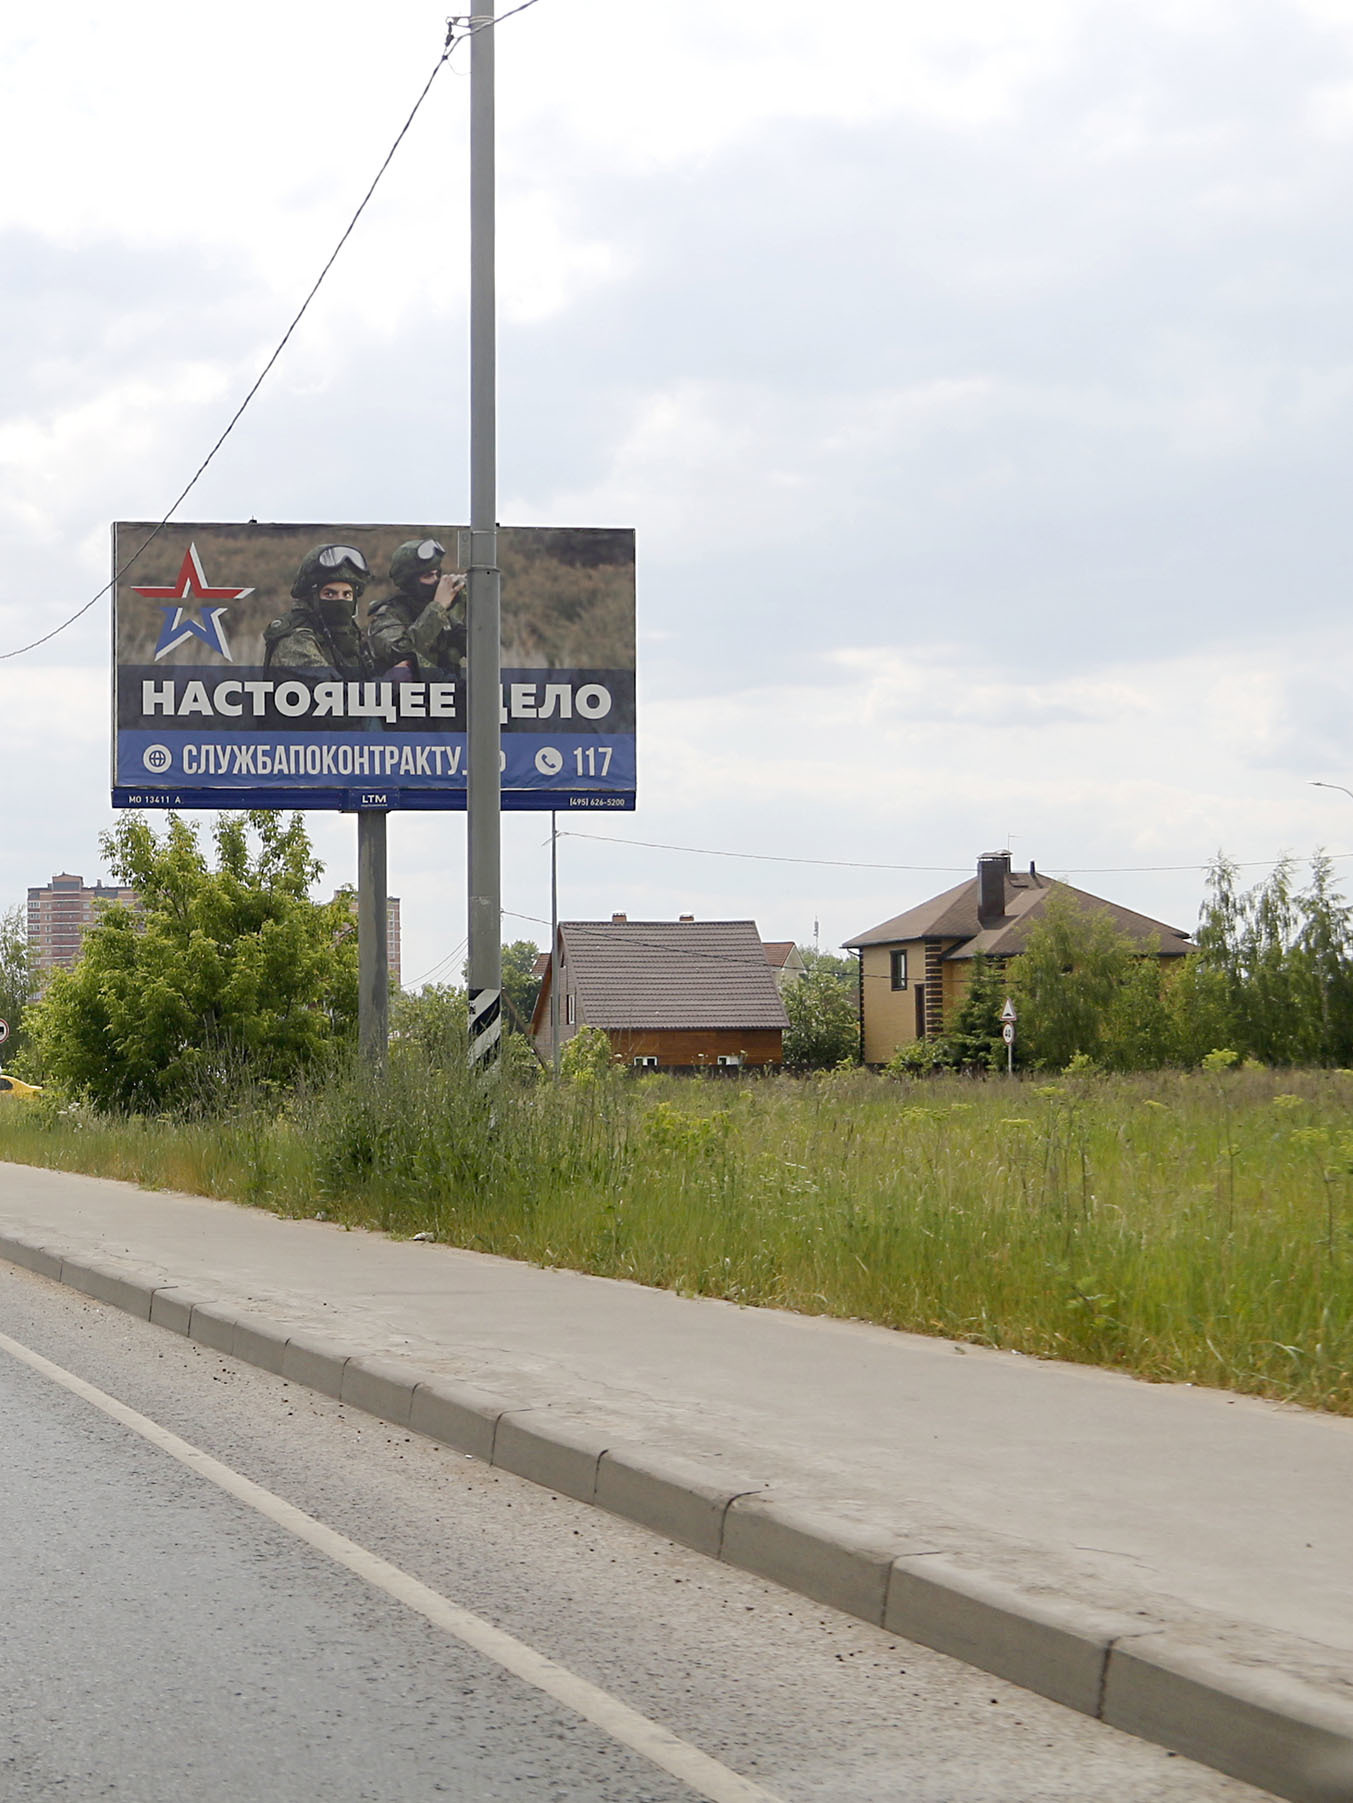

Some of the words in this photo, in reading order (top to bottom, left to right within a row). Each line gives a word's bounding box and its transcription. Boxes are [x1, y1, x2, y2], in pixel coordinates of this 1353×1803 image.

[141, 679, 457, 724] НАСТОЯЩЕЕ
[500, 683, 612, 725] ЕЛО
[182, 743, 507, 777] СЛУЖБАПОКОНТРАКТУ.
[573, 746, 613, 777] 117
[145, 795, 170, 804] 13411
[362, 794, 387, 804] LTM
[569, 796, 589, 806] (495)
[590, 798, 625, 806] 626-5200
